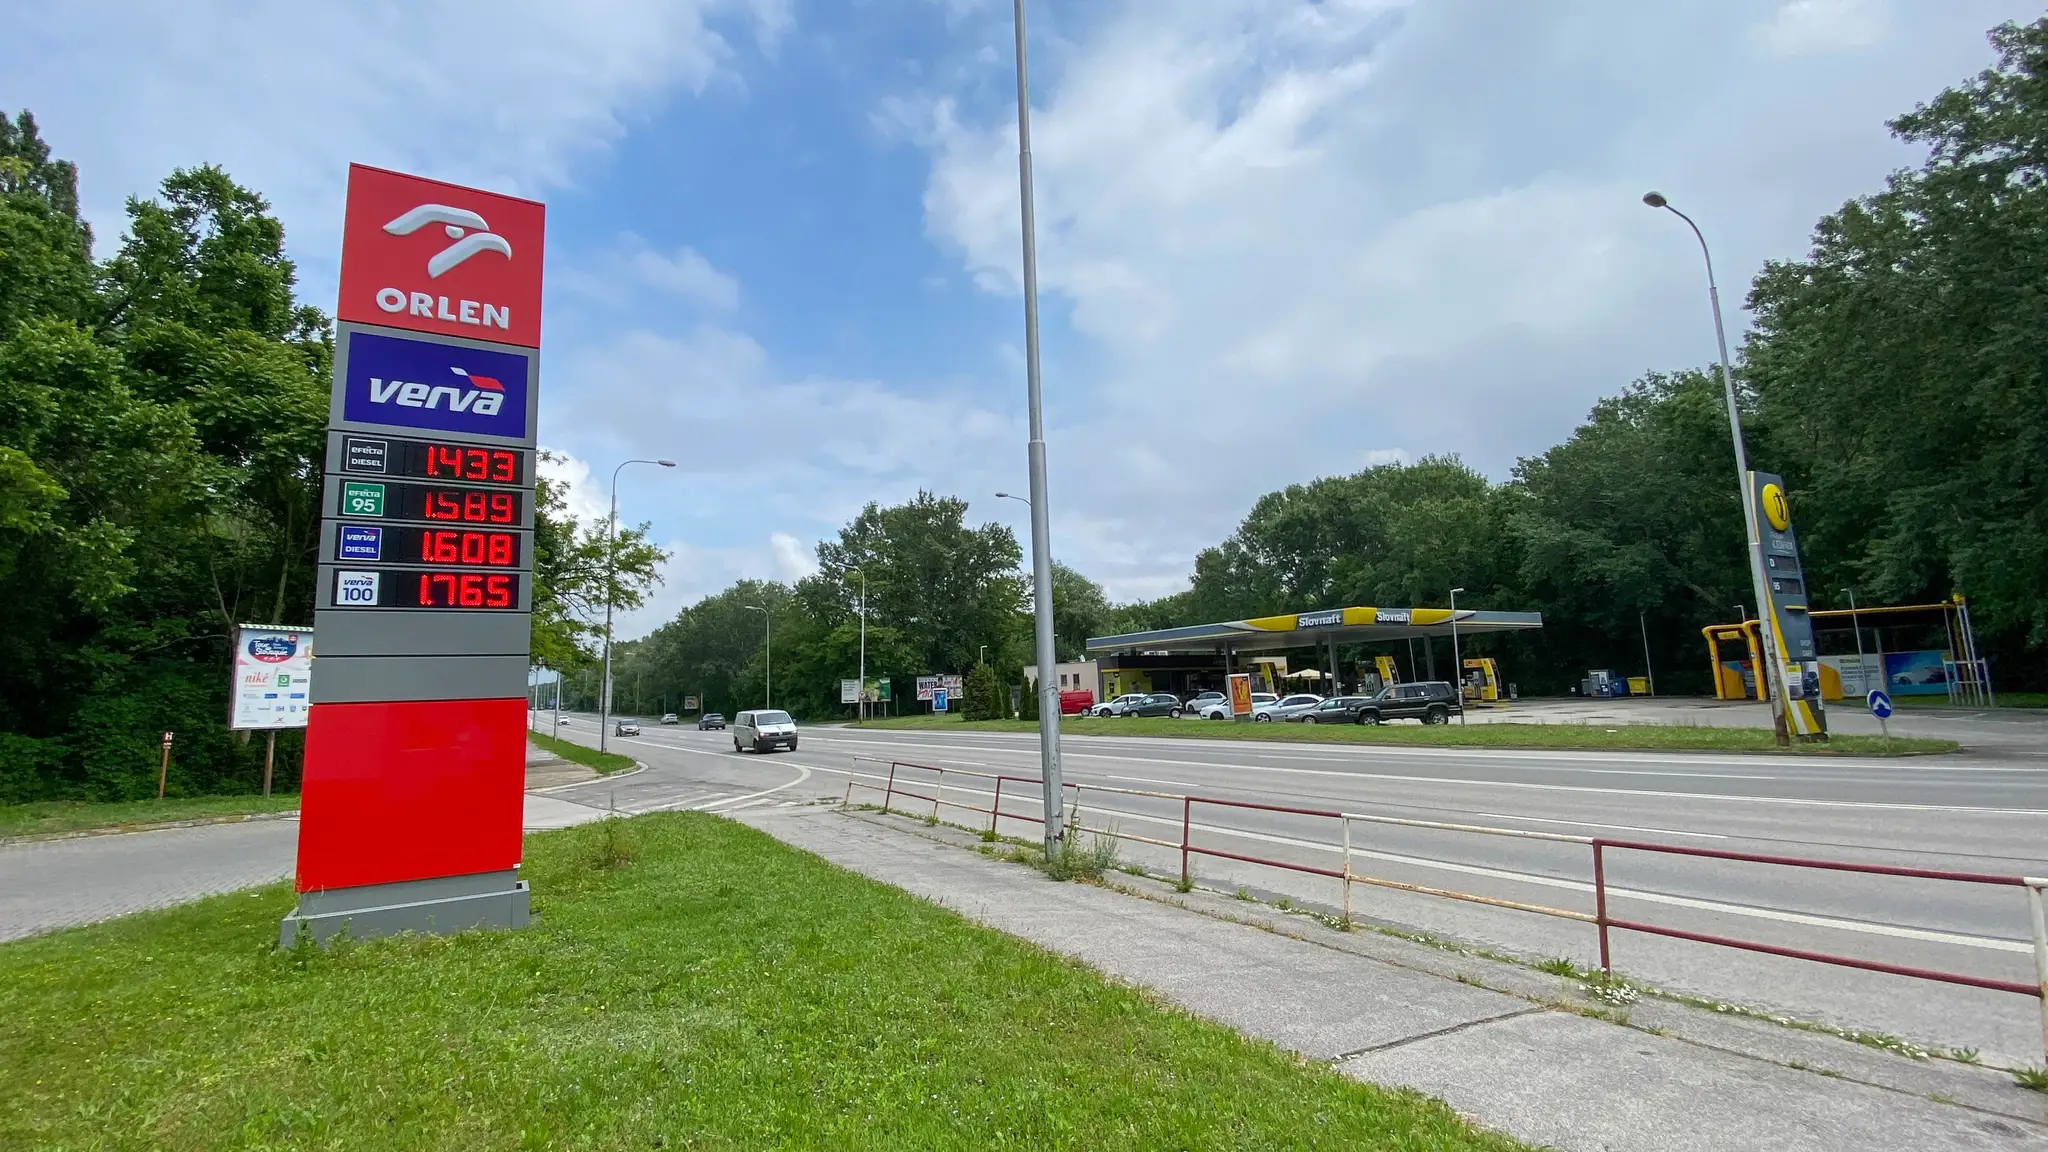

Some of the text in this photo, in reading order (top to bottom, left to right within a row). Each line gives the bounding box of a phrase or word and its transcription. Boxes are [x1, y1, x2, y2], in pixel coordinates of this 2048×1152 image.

[376, 287, 509, 330] ORLEN
[370, 377, 505, 416] verva
[351, 458, 382, 467] DIESEL
[427, 446, 514, 481] 1.433
[351, 498, 376, 513] 95
[425, 491, 512, 523] 1.589
[346, 533, 376, 542] verva
[345, 545, 377, 554] DIESEL
[422, 531, 512, 564] 1.608
[343, 578, 374, 586] verva
[343, 587, 374, 601] 100
[419, 574, 511, 607] 1.765
[1299, 614, 1341, 627] Slovnaft
[244, 671, 269, 684] niké
[918, 681, 938, 690] WATER
